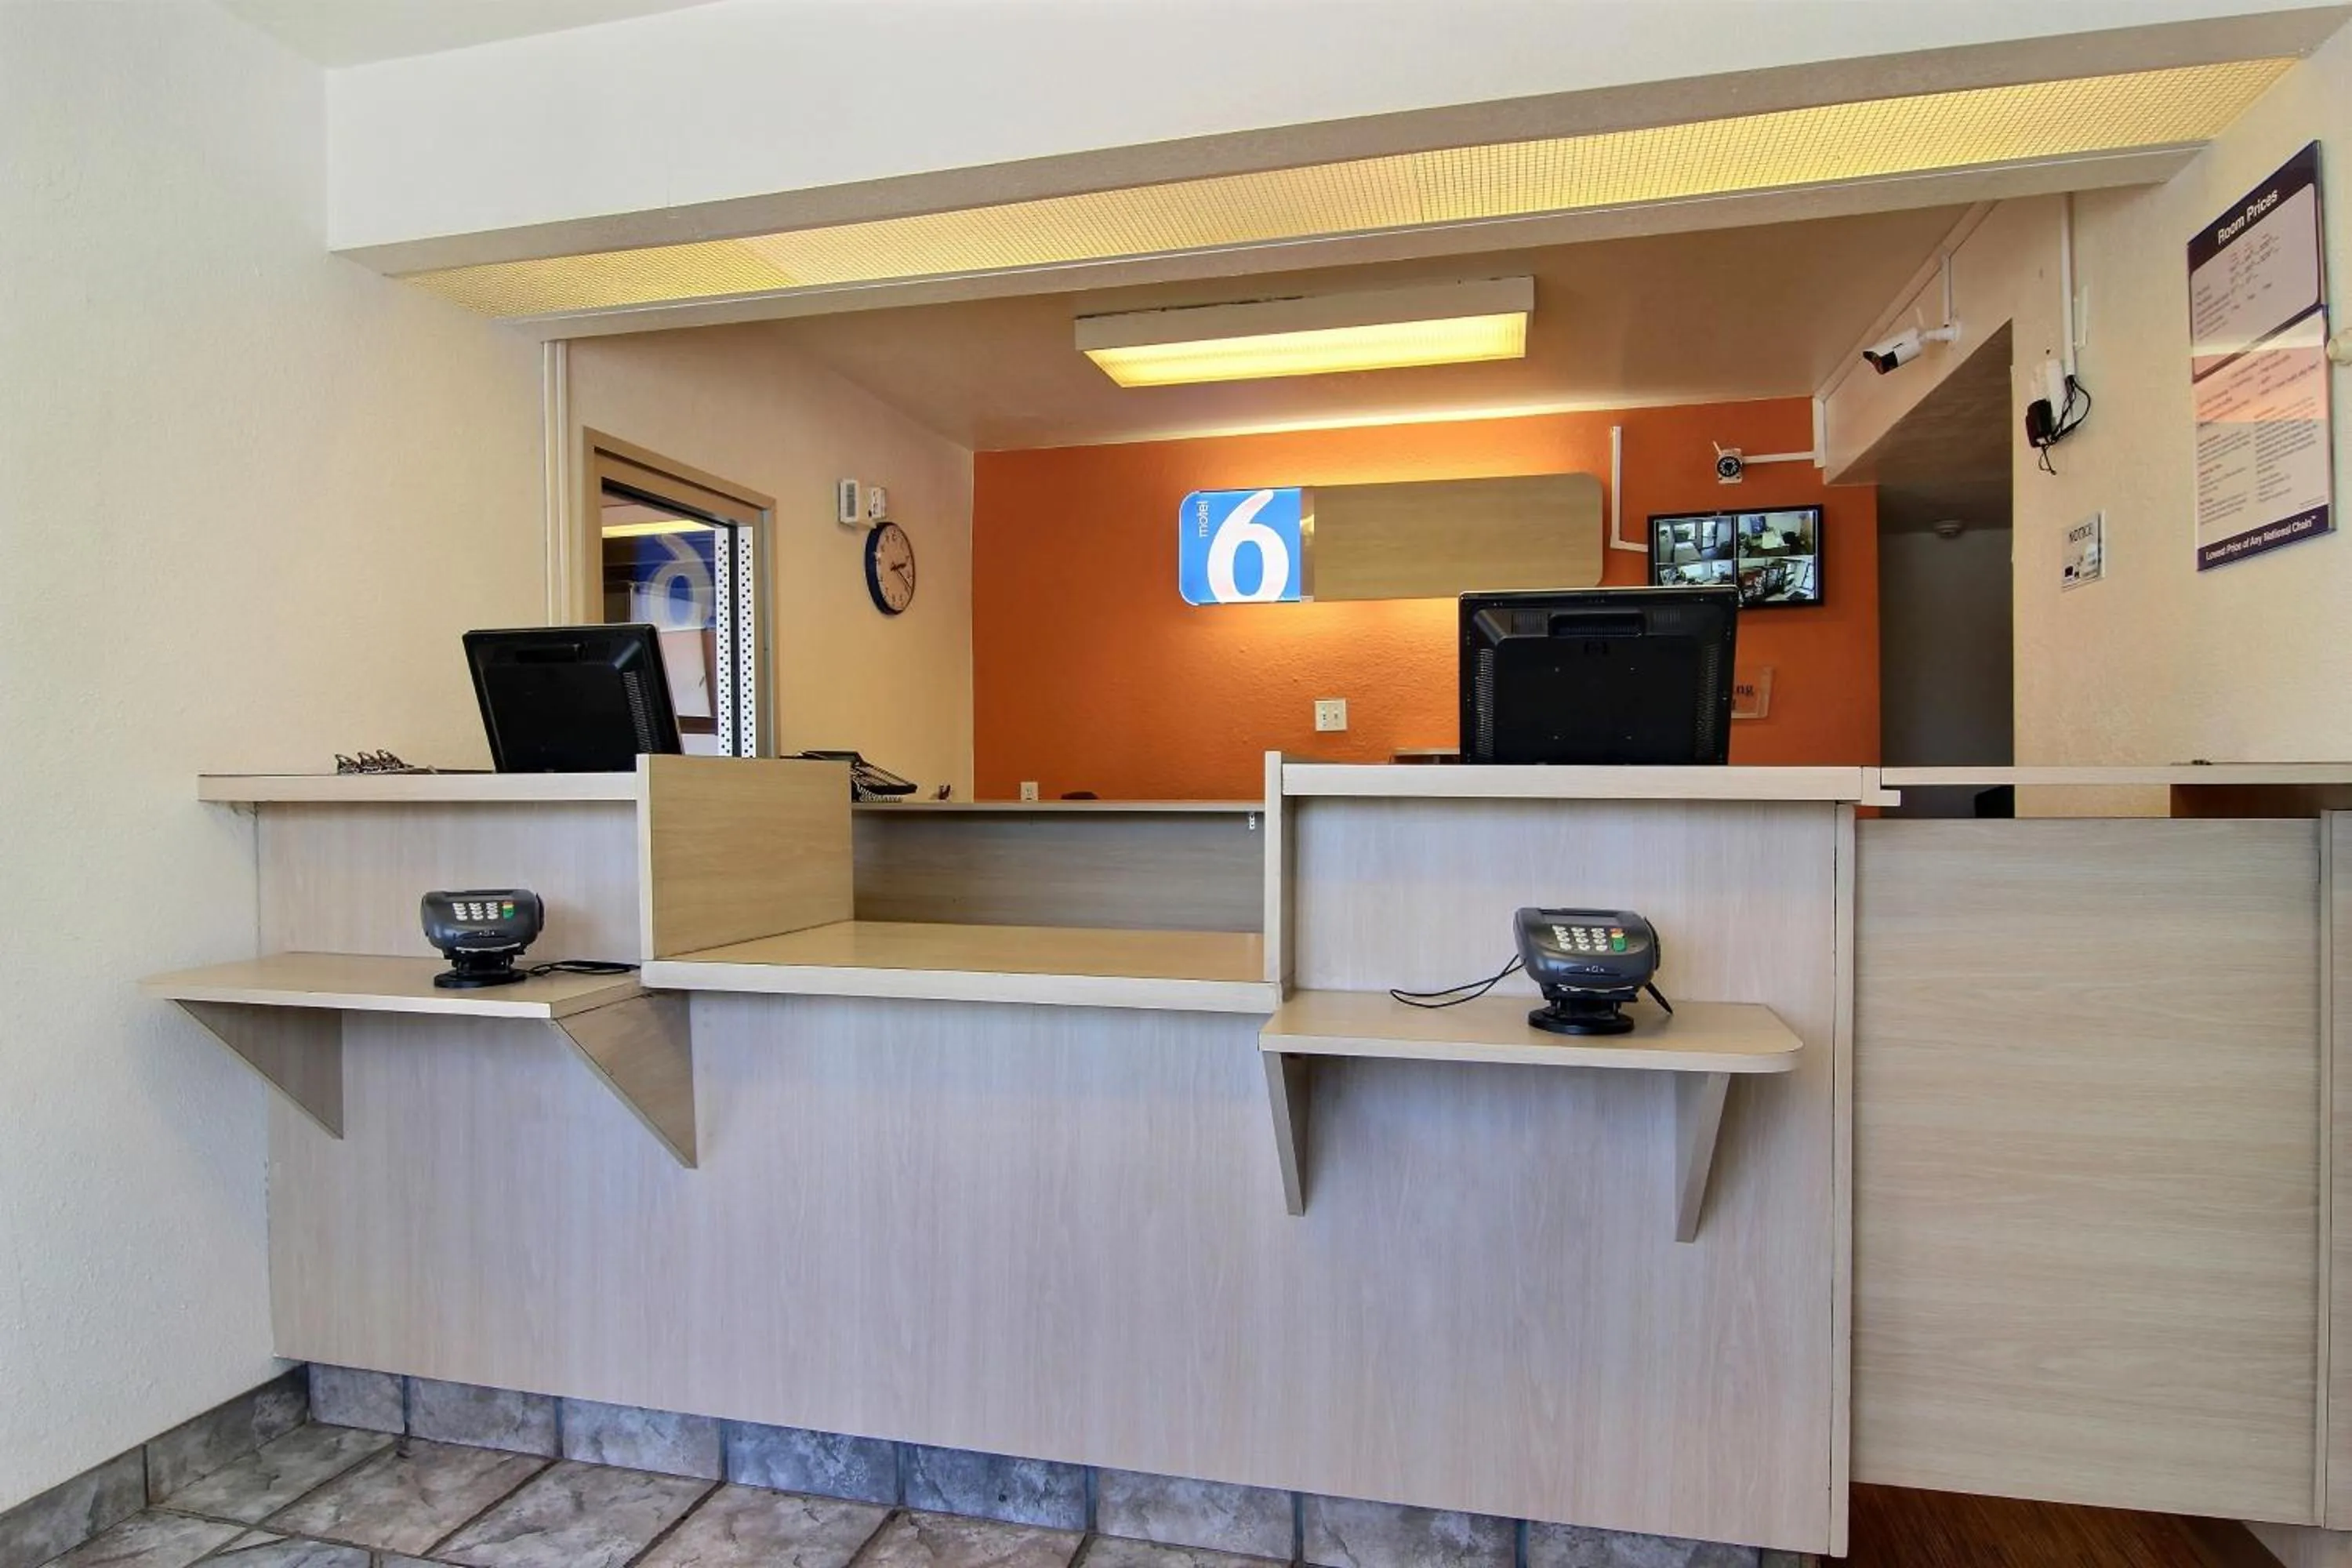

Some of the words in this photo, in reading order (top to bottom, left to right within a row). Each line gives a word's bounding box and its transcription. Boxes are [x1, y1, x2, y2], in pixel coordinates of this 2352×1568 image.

[2218, 214, 2245, 244] Room
[2246, 190, 2278, 223] Prices
[1196, 501, 1208, 538] motel
[2250, 535, 2263, 546] Any
[1207, 489, 1289, 604] 6
